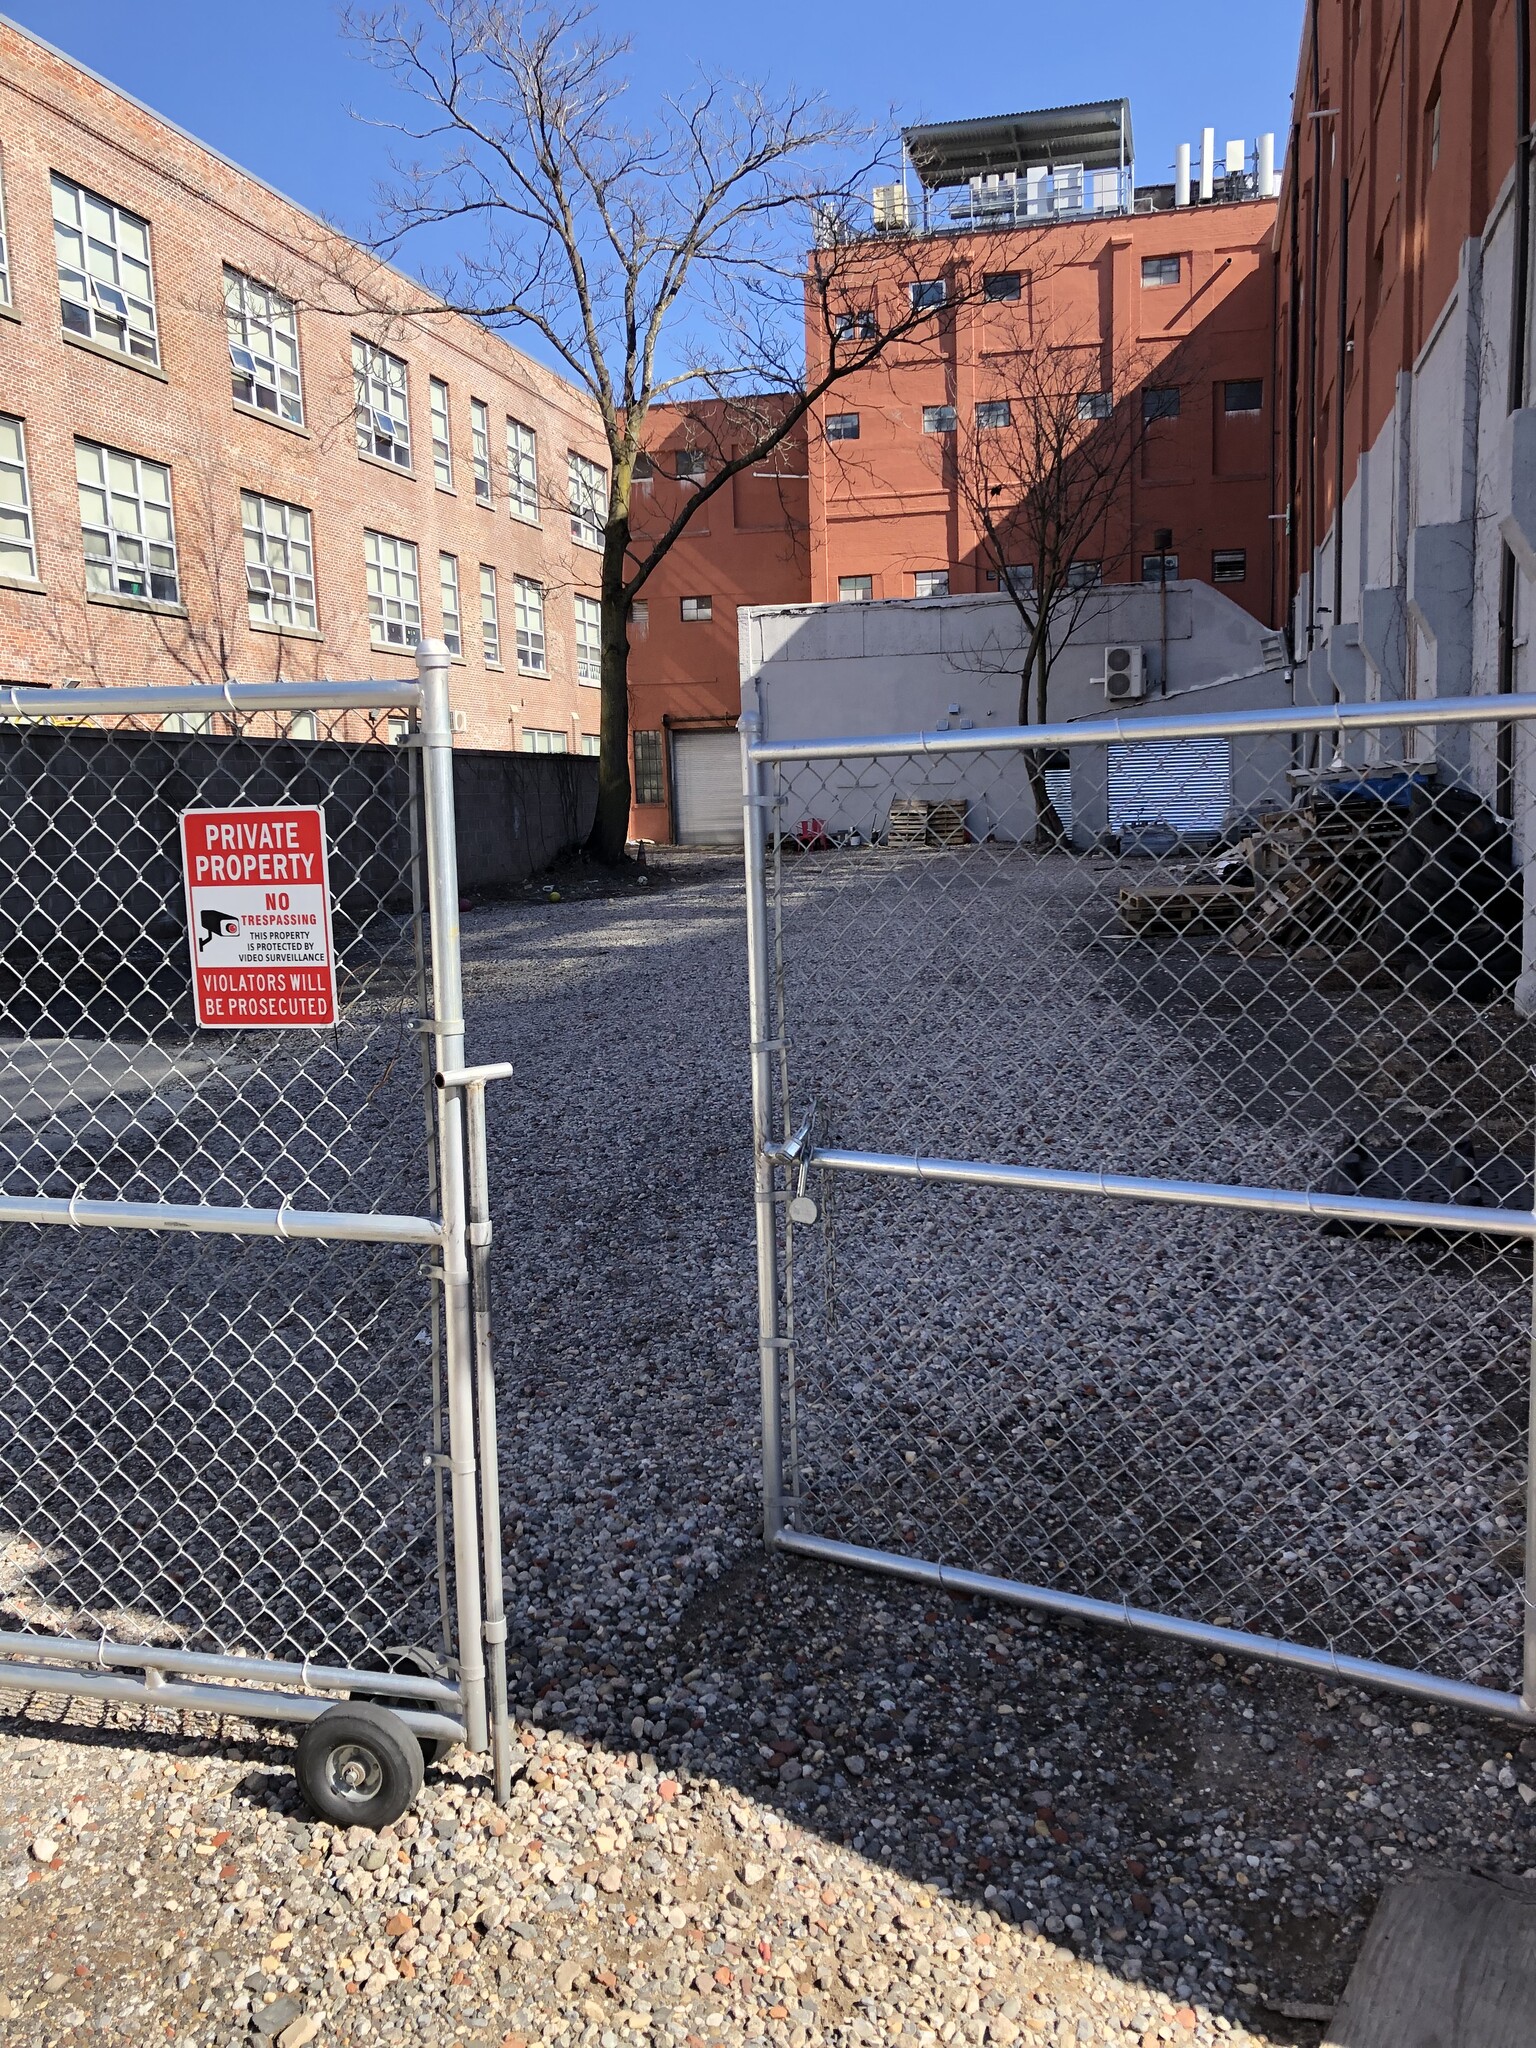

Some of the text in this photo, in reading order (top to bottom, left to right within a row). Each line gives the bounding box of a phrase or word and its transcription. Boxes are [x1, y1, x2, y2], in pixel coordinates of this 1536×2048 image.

[206, 823, 299, 850] PRIVATE
[196, 853, 314, 880] PROPERTY
[266, 893, 289, 910] NO
[241, 914, 316, 926] TRESPASSING
[250, 932, 268, 940] THIS
[247, 942, 314, 951] IS PROTECTED BY
[239, 953, 324, 962] VIDEO SURVEILLANCE
[203, 974, 325, 992] VIOLATORS WILL
[206, 998, 327, 1016] BE PROSECUTED
